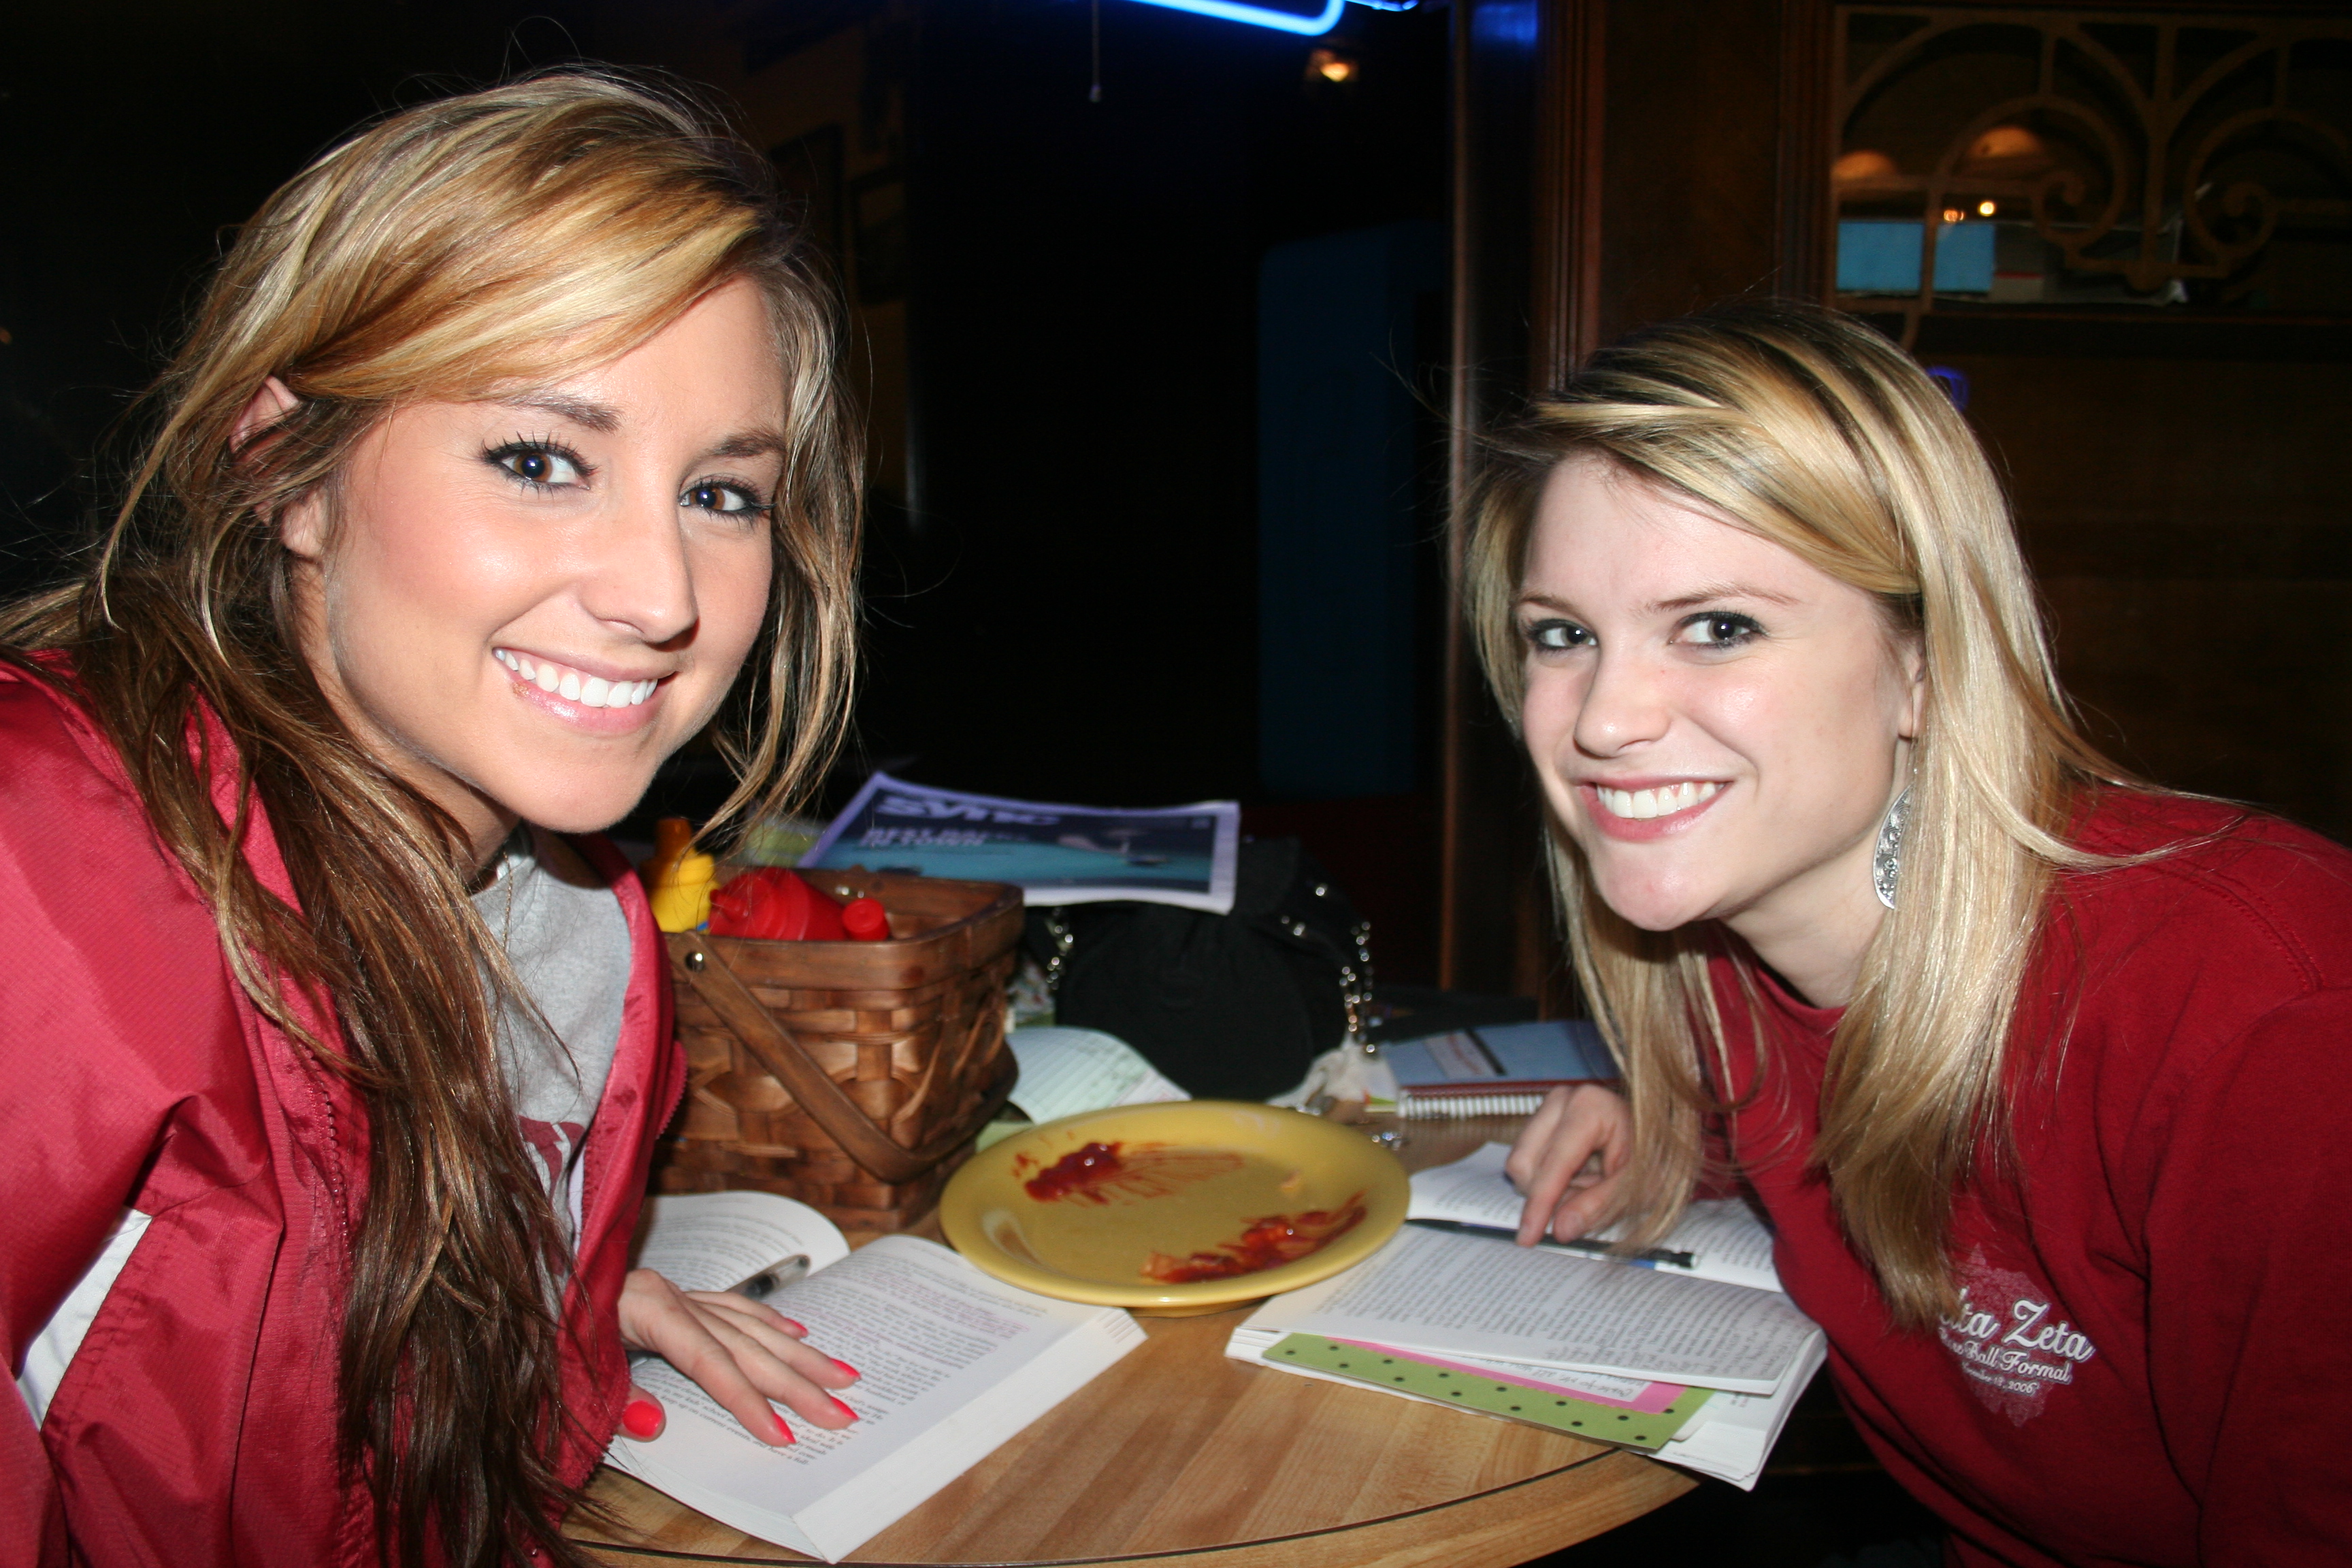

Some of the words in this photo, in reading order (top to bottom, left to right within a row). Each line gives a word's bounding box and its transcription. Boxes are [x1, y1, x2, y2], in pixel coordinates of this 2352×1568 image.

[2001, 1299, 2095, 1361] Zeta
[1999, 1350, 2071, 1382] Formal
[2008, 1380, 2037, 1394] 2006
